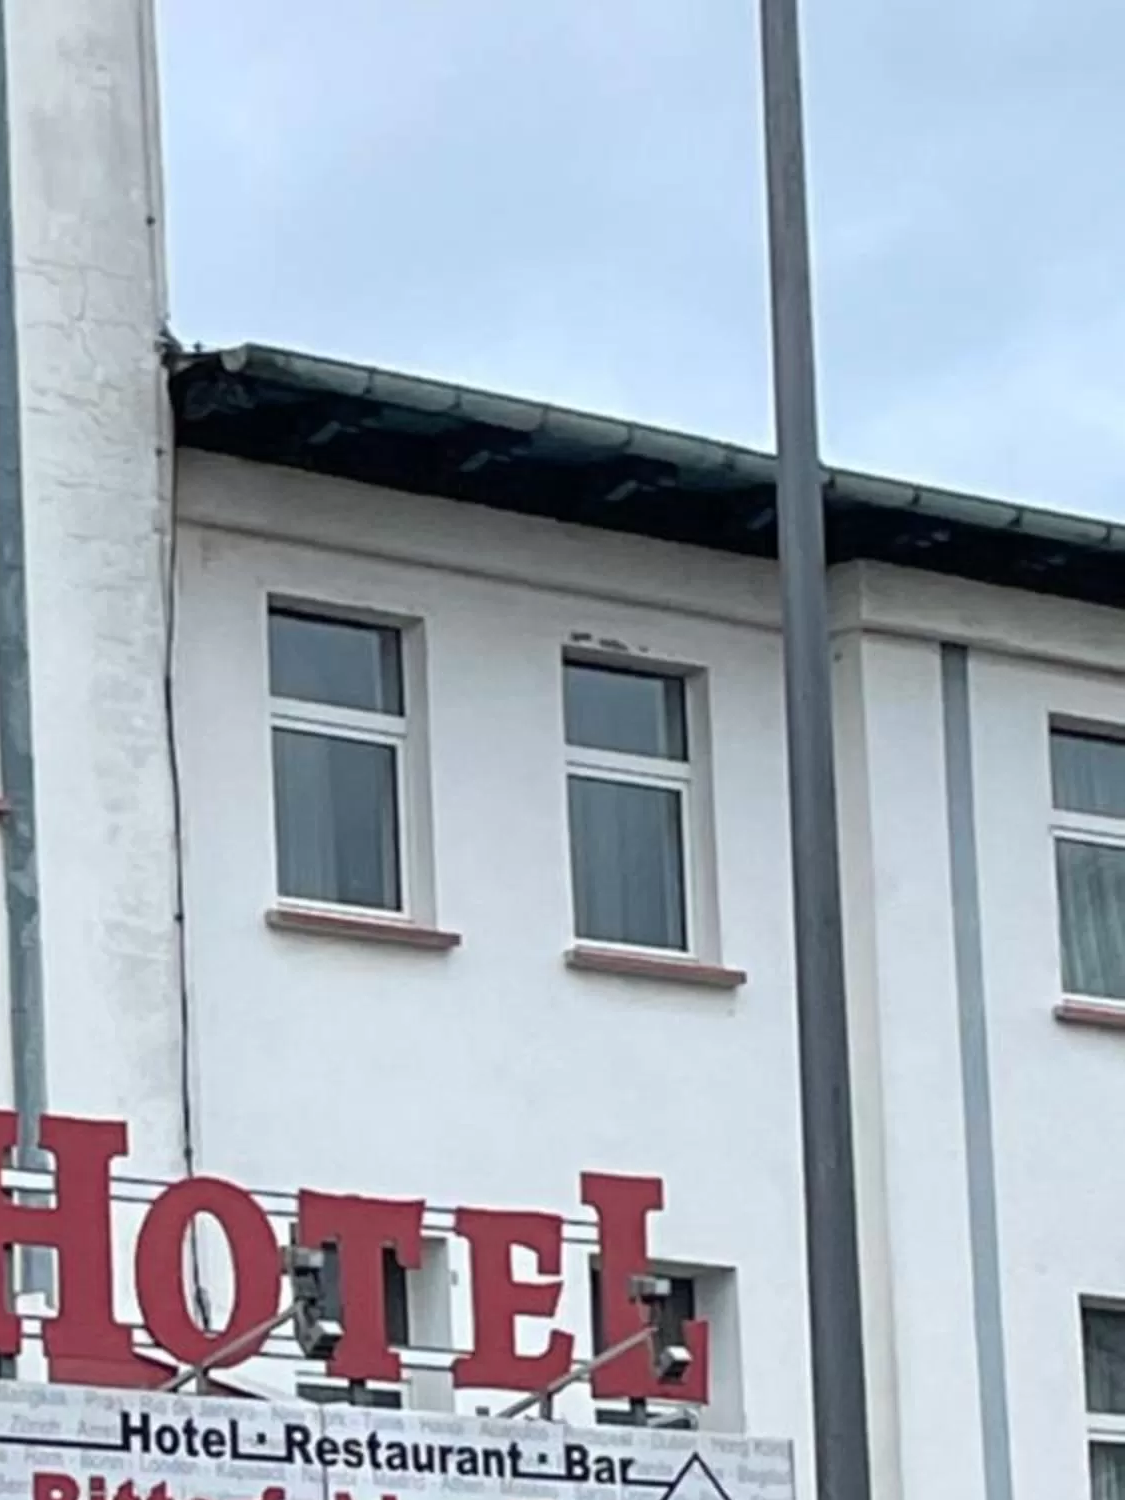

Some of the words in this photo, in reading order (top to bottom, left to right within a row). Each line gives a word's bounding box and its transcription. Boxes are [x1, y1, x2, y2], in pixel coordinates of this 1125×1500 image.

[121, 1410, 239, 1460] Hotel
[284, 1423, 522, 1479] Restaurant
[564, 1443, 635, 1485] Bar
